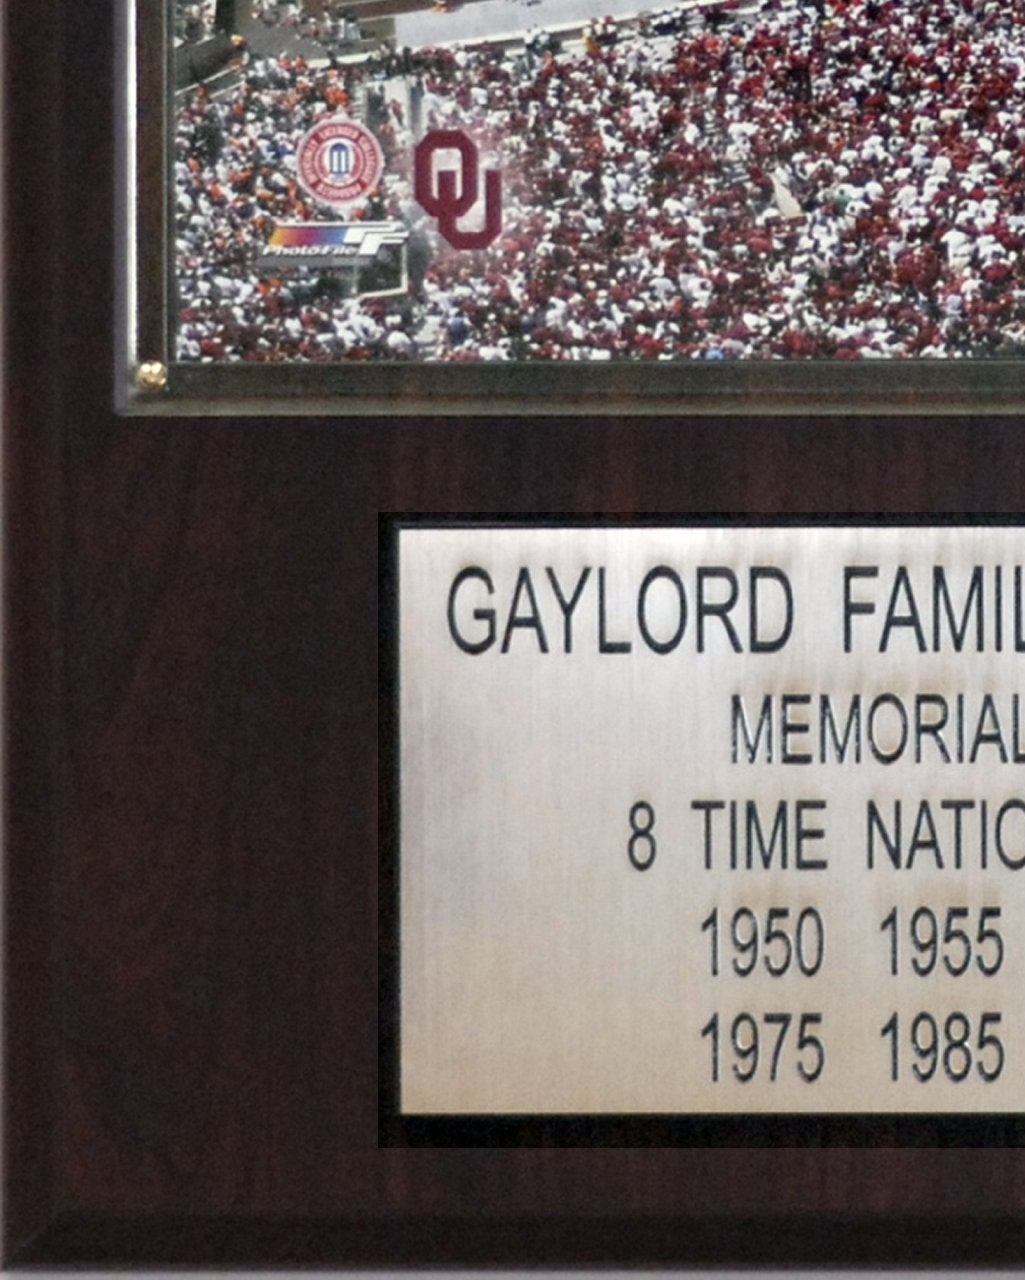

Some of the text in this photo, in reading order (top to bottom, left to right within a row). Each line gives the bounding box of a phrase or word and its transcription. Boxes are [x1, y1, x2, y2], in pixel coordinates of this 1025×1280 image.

[447, 564, 794, 656] GAYLORD
[626, 800, 657, 872] 8
[691, 799, 828, 871] TIME
[700, 906, 824, 978] 1950
[880, 906, 1004, 978] 1955
[700, 1012, 825, 1084] 1975
[881, 1011, 1005, 1084] 1985
